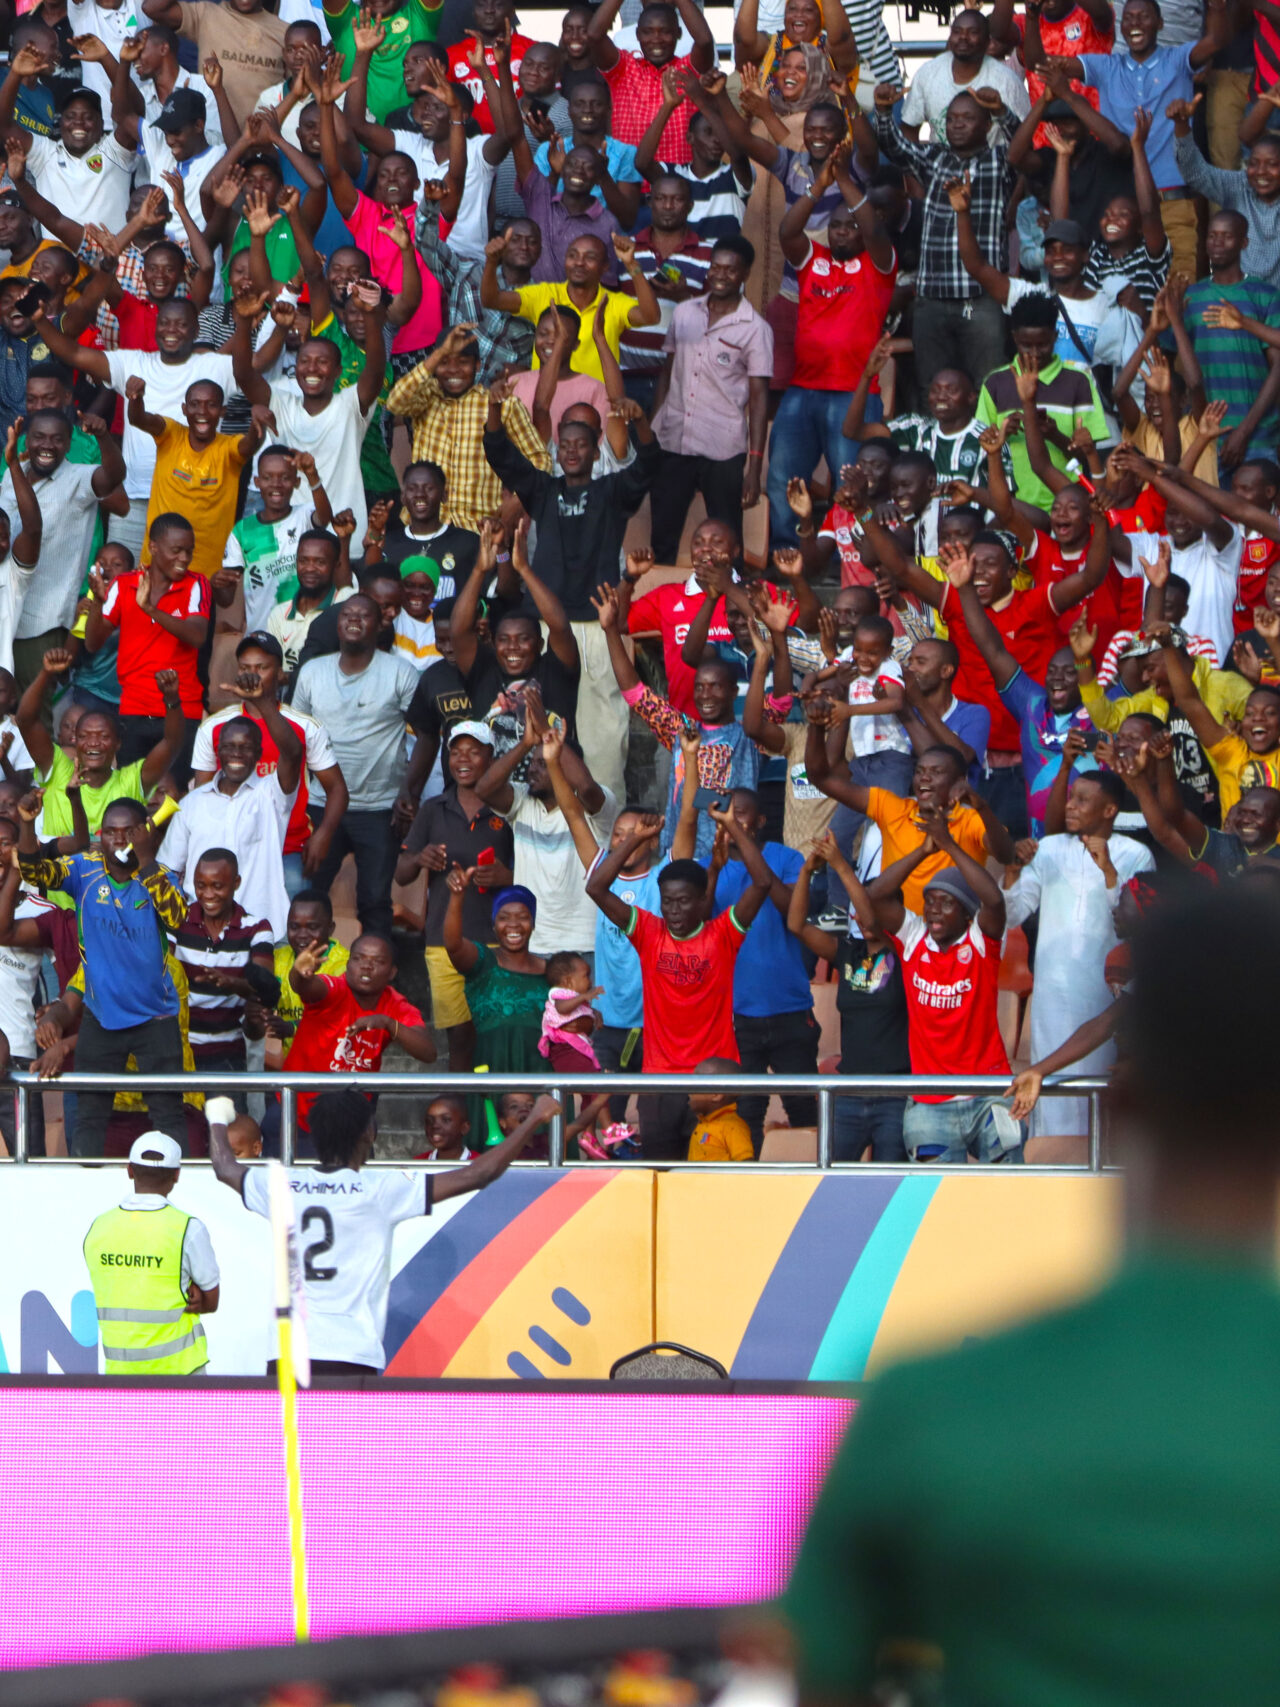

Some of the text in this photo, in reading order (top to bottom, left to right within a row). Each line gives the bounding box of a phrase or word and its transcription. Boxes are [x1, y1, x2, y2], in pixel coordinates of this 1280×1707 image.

[221, 50, 276, 69] BALMAIN
[913, 972, 972, 997] Emirates
[917, 991, 962, 1010] FLY BETTER
[289, 1180, 346, 1195] RAHIMA
[300, 1205, 339, 1282] 2
[100, 1255, 163, 1271] SECURITY
